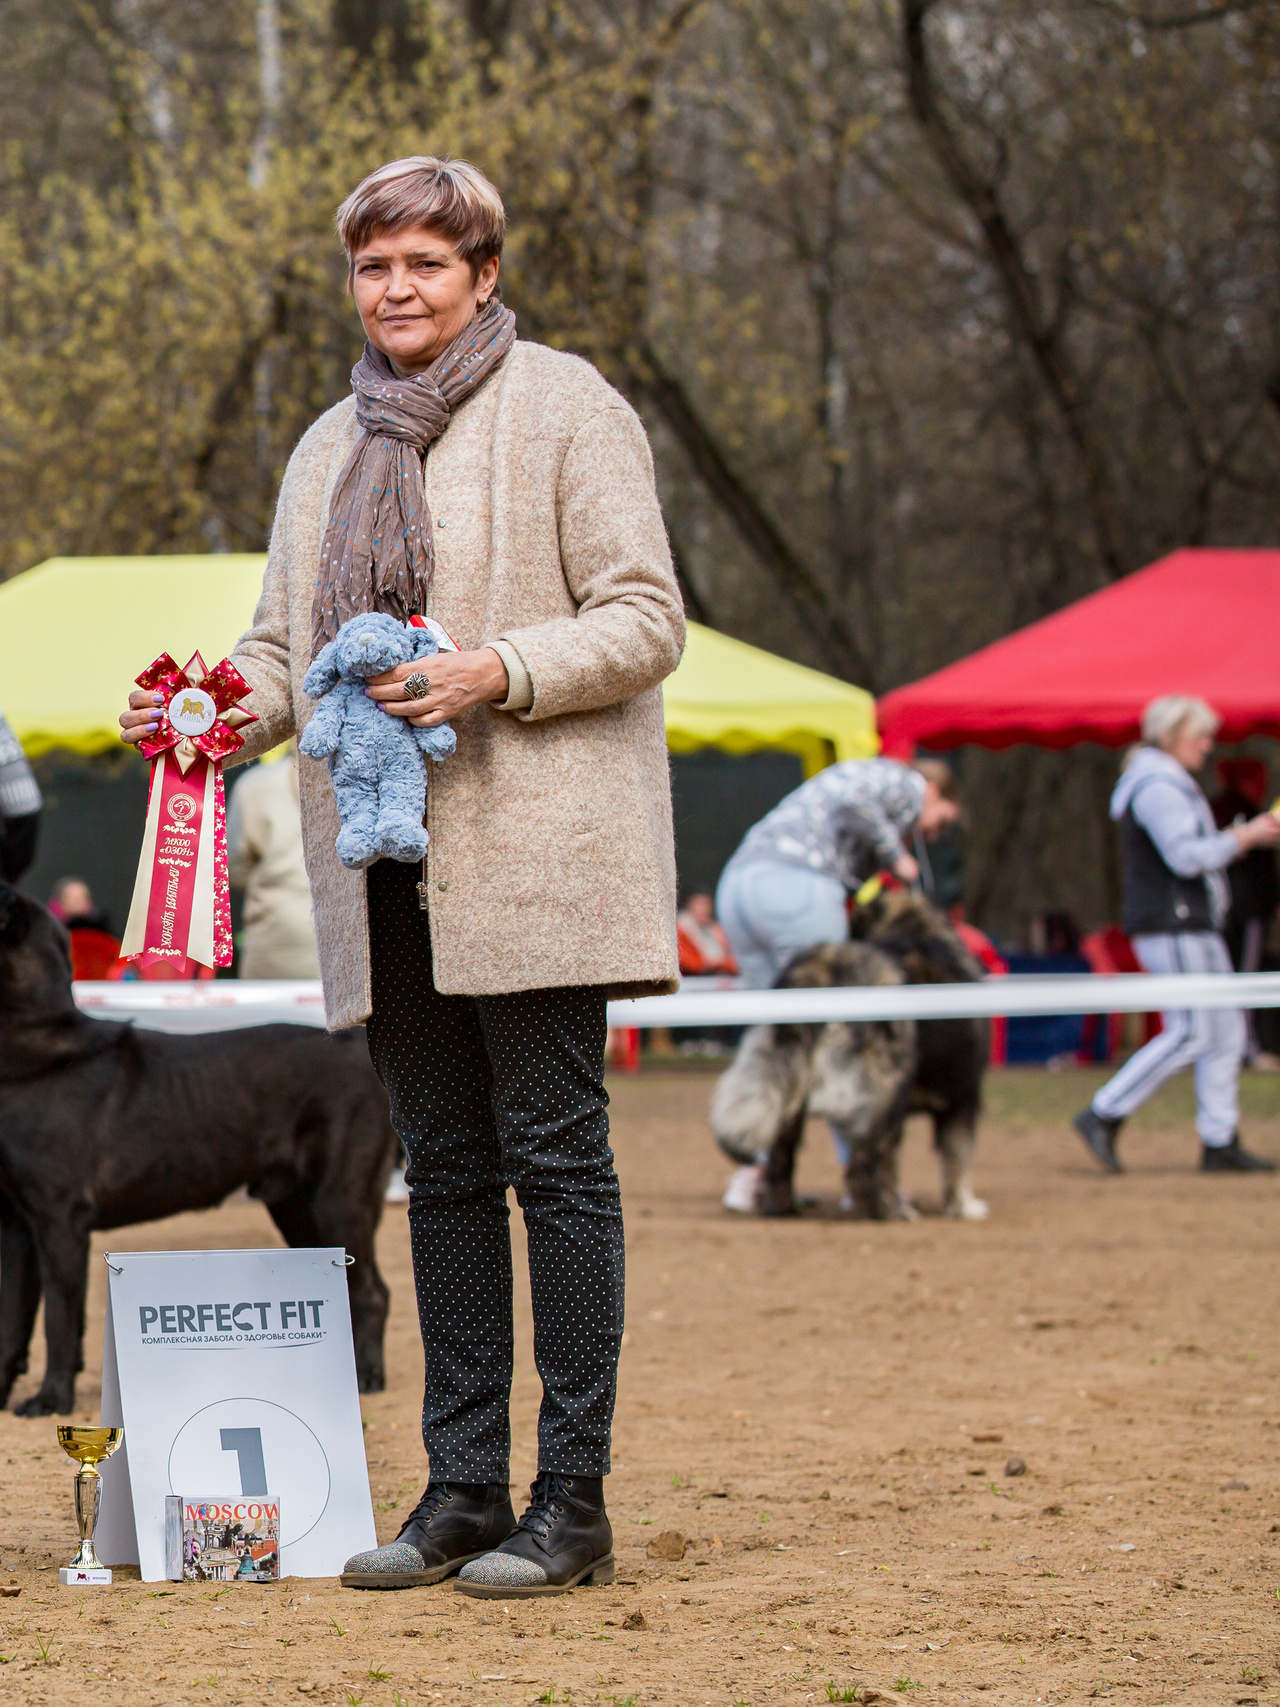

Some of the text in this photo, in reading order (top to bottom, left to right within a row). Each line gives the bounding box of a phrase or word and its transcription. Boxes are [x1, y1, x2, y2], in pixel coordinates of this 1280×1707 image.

[139, 1300, 324, 1334] PERFECT FIT
[142, 1335, 203, 1344] КОМПЛЕКСНАЯ
[204, 1335, 235, 1343] ЗАБОТА
[244, 1333, 286, 1342] ЗДОРОВЬЕ
[219, 1427, 268, 1496] 1
[185, 1503, 278, 1520] MOSCOW
